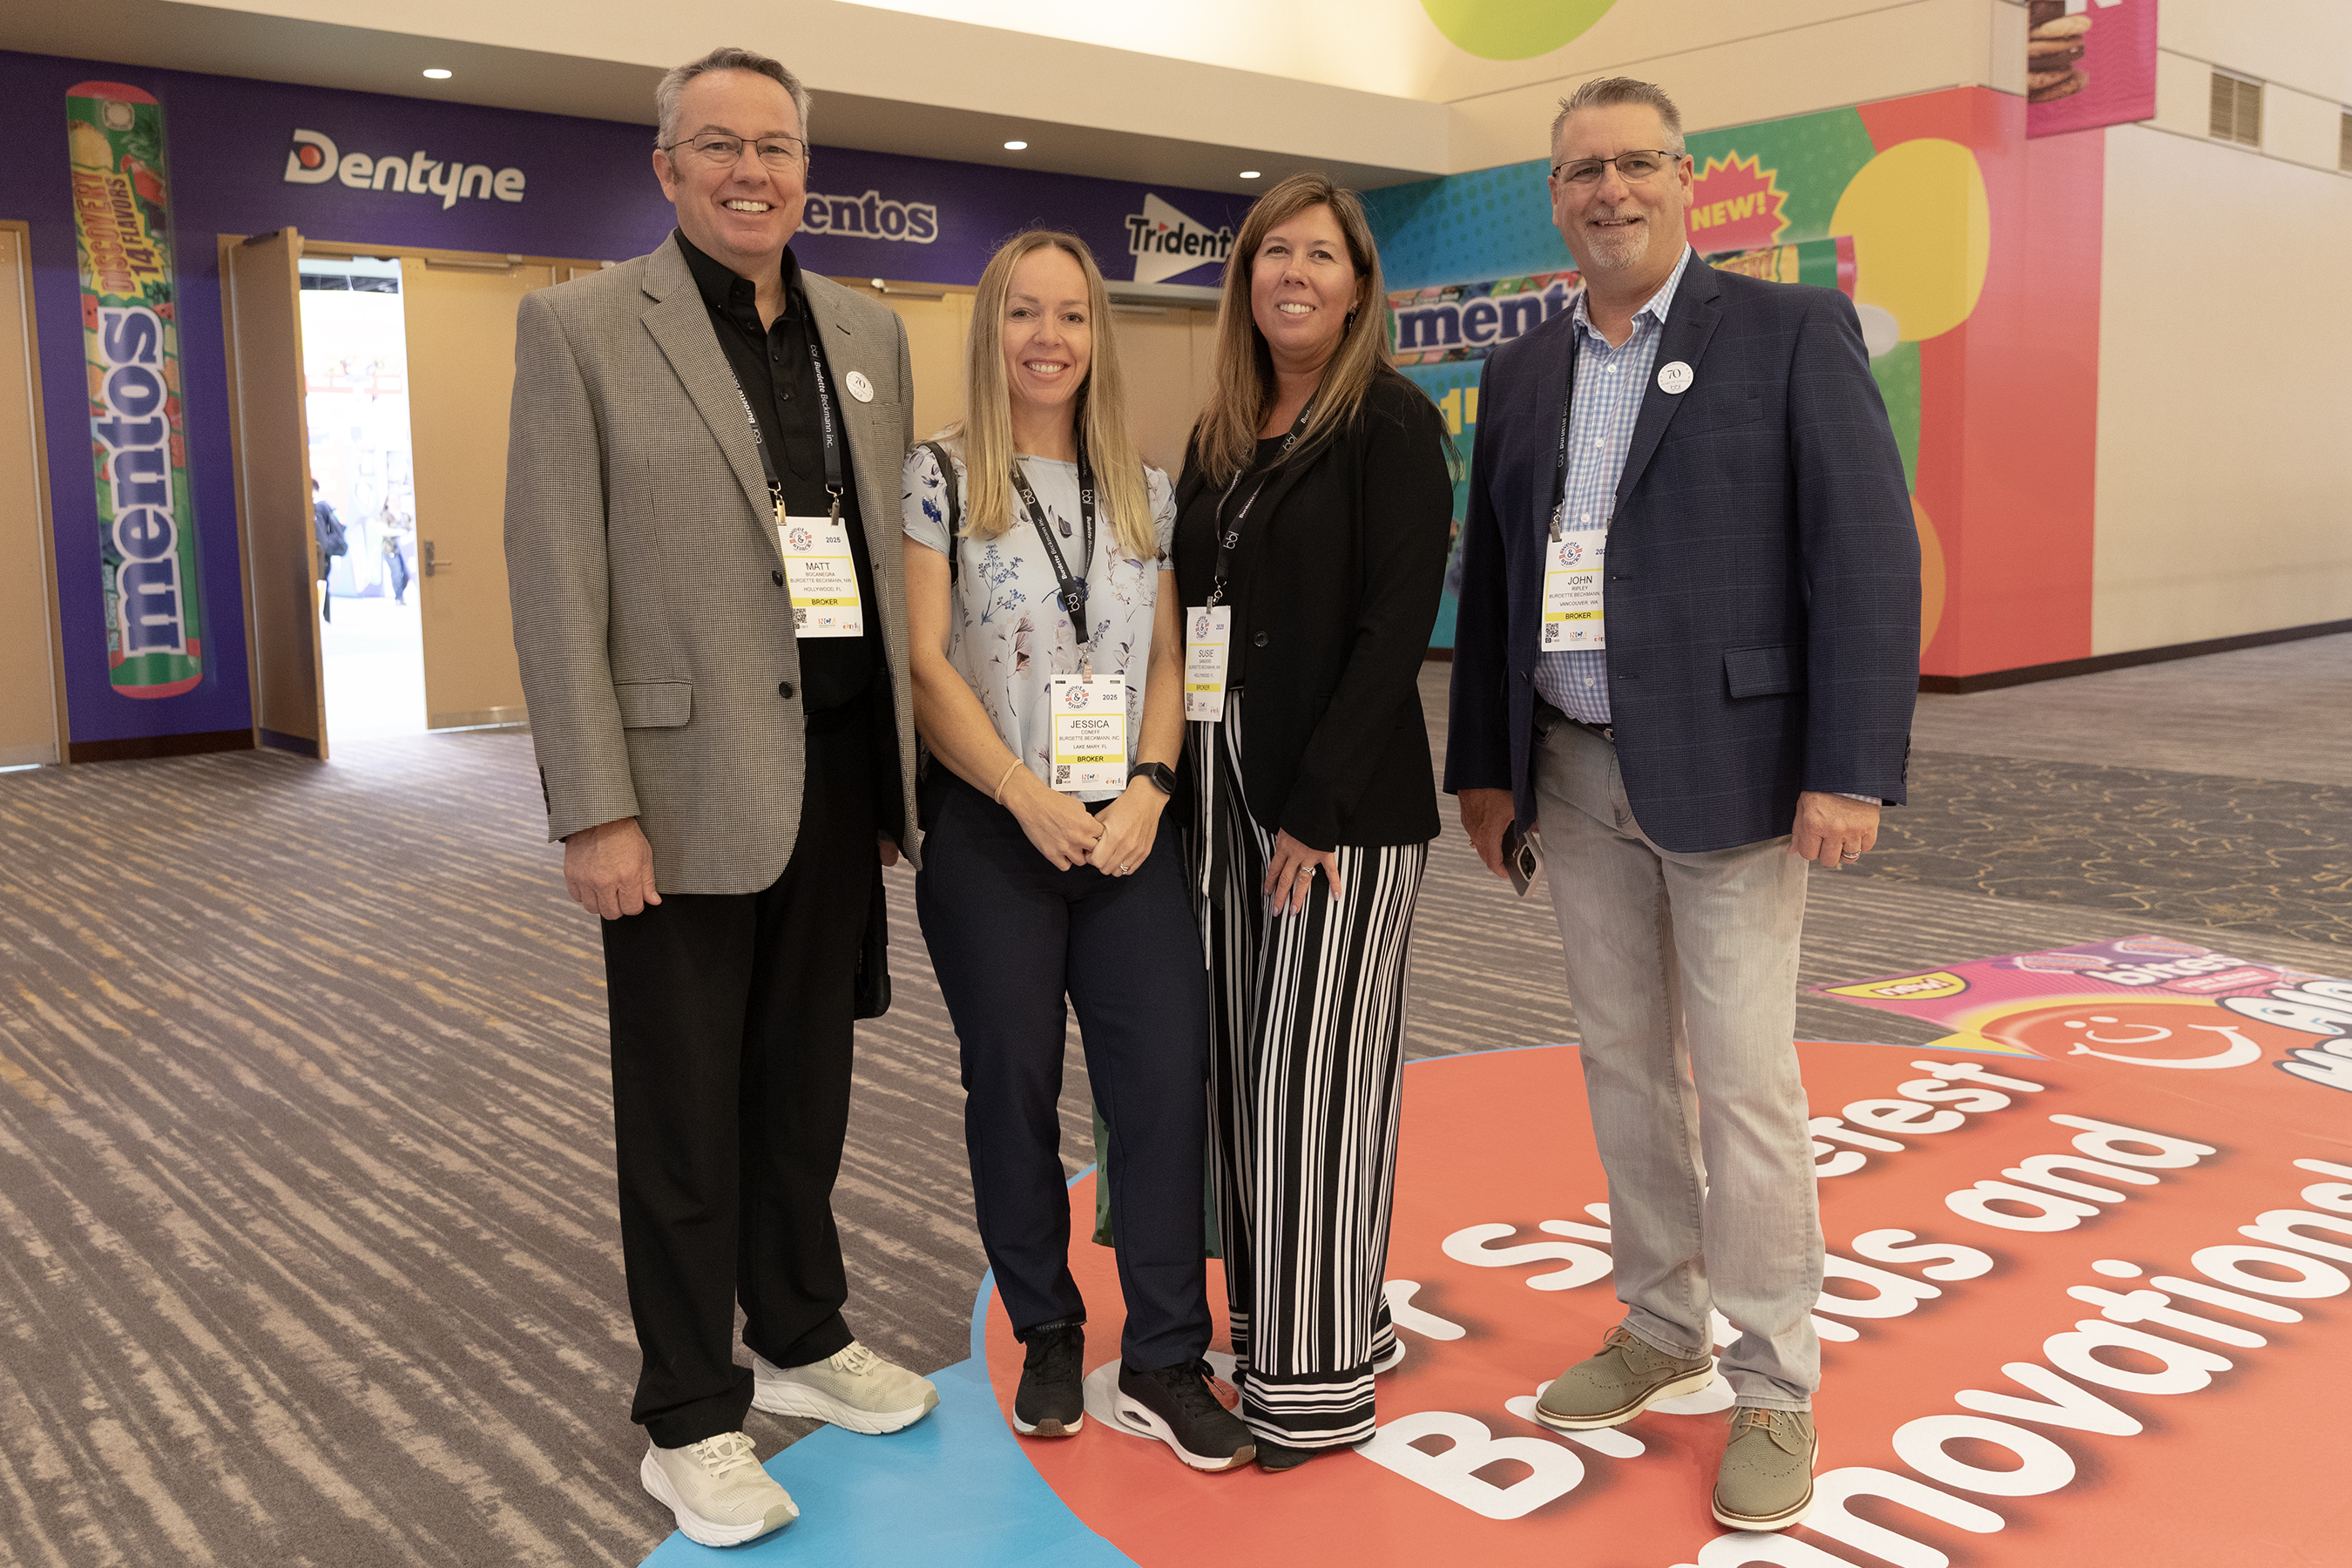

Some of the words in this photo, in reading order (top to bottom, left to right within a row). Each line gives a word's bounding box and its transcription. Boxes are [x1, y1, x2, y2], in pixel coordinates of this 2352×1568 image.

[284, 128, 526, 211] Dentyne
[105, 177, 143, 245] FLAVORS
[801, 190, 938, 244] entos
[1690, 191, 1767, 232] NEW!
[72, 173, 136, 293] DISCOVERY
[1129, 217, 1232, 258] Trident
[125, 246, 159, 277] 14
[1396, 279, 1585, 354] ment
[814, 361, 826, 393] Burdette
[855, 375, 866, 389] 70
[1666, 368, 1681, 380] 70
[821, 394, 833, 433] Beckmann
[826, 434, 835, 449] inc.
[98, 306, 186, 658] mentos
[1021, 488, 1036, 505] bbi
[1081, 489, 1093, 505] bbi
[1037, 517, 1046, 529] inc.
[797, 534, 804, 544] &
[1043, 527, 1058, 555] Beckmann
[1223, 531, 1240, 550] bbi
[1558, 541, 1580, 555] sweets
[1560, 553, 1581, 566] snacks
[1566, 549, 1574, 558] &
[805, 562, 830, 571] MATT
[1053, 555, 1068, 580] Burdette
[1567, 575, 1593, 585] JOHN
[1065, 592, 1081, 613] bbi
[1565, 612, 1592, 620] BROKER
[1198, 649, 1214, 658] SUSIE
[1065, 685, 1086, 698] sweets
[1073, 693, 1080, 702] &
[1067, 698, 1088, 709] snacks
[1070, 720, 1110, 729] JESSICA
[2085, 953, 2249, 986] bites
[1869, 977, 1954, 997] new!
[1353, 1229, 1994, 1519] Brds
[1944, 1114, 2217, 1233] and
